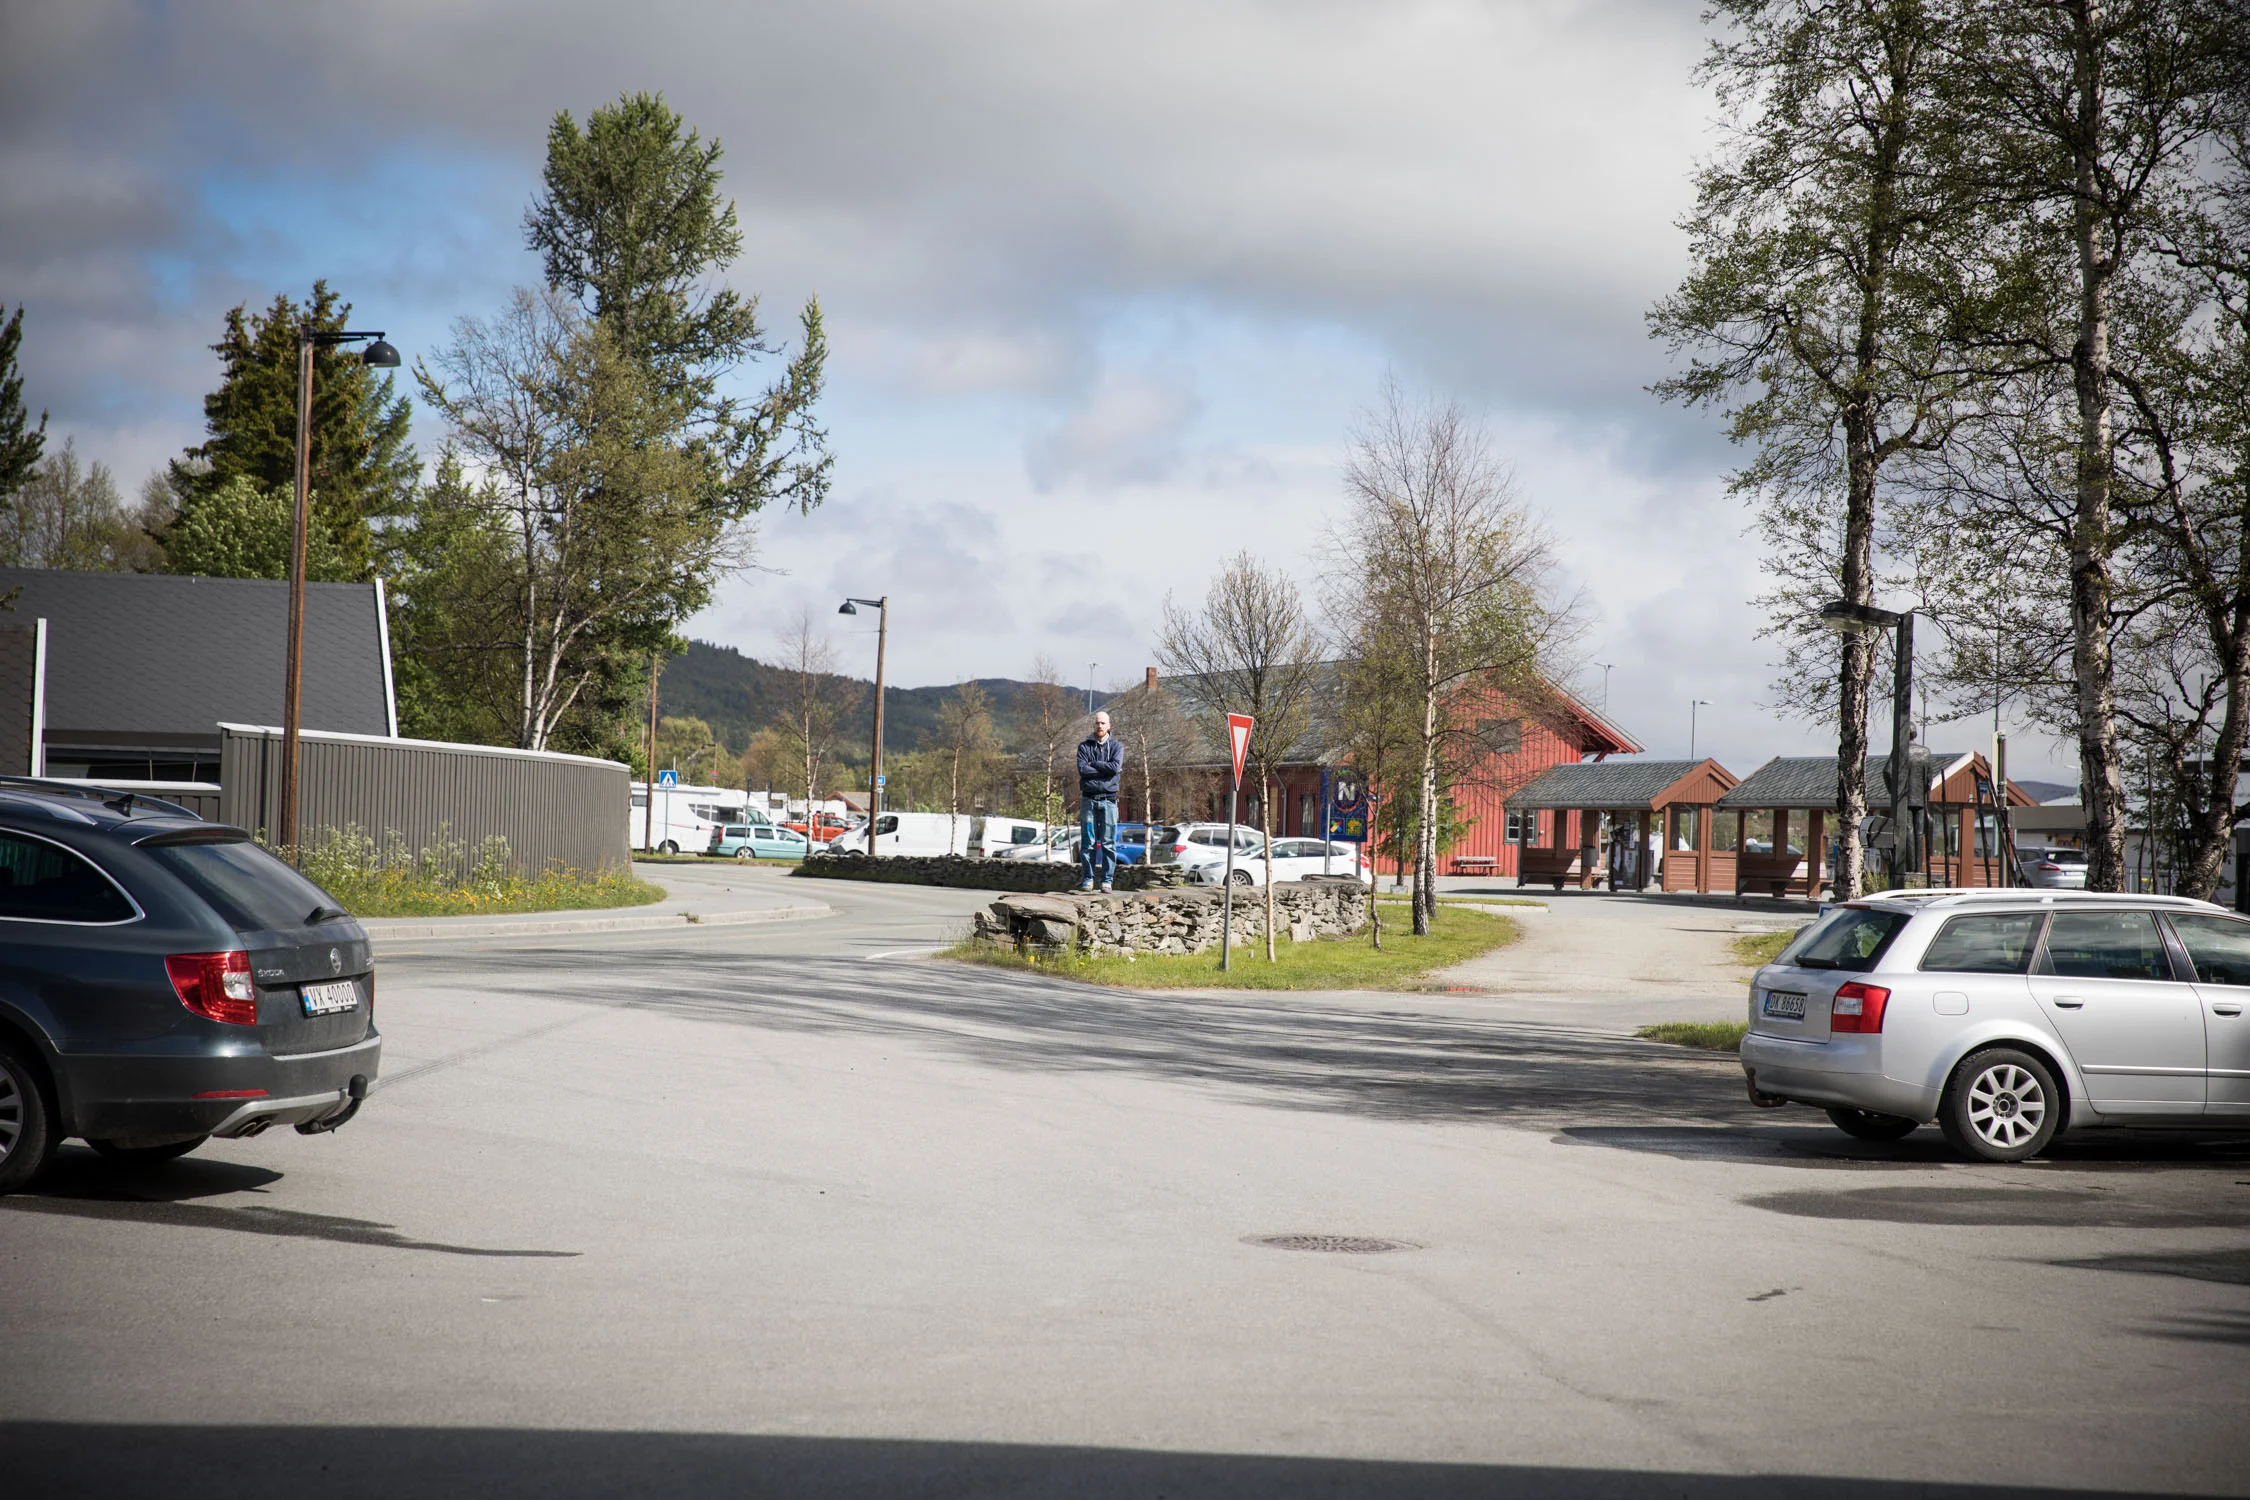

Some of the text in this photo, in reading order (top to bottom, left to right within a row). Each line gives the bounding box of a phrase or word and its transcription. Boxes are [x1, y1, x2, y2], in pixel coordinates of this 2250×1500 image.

[1338, 781, 1355, 801] N
[309, 983, 354, 1007] VX 40000
[1770, 994, 1780, 1009] DK
